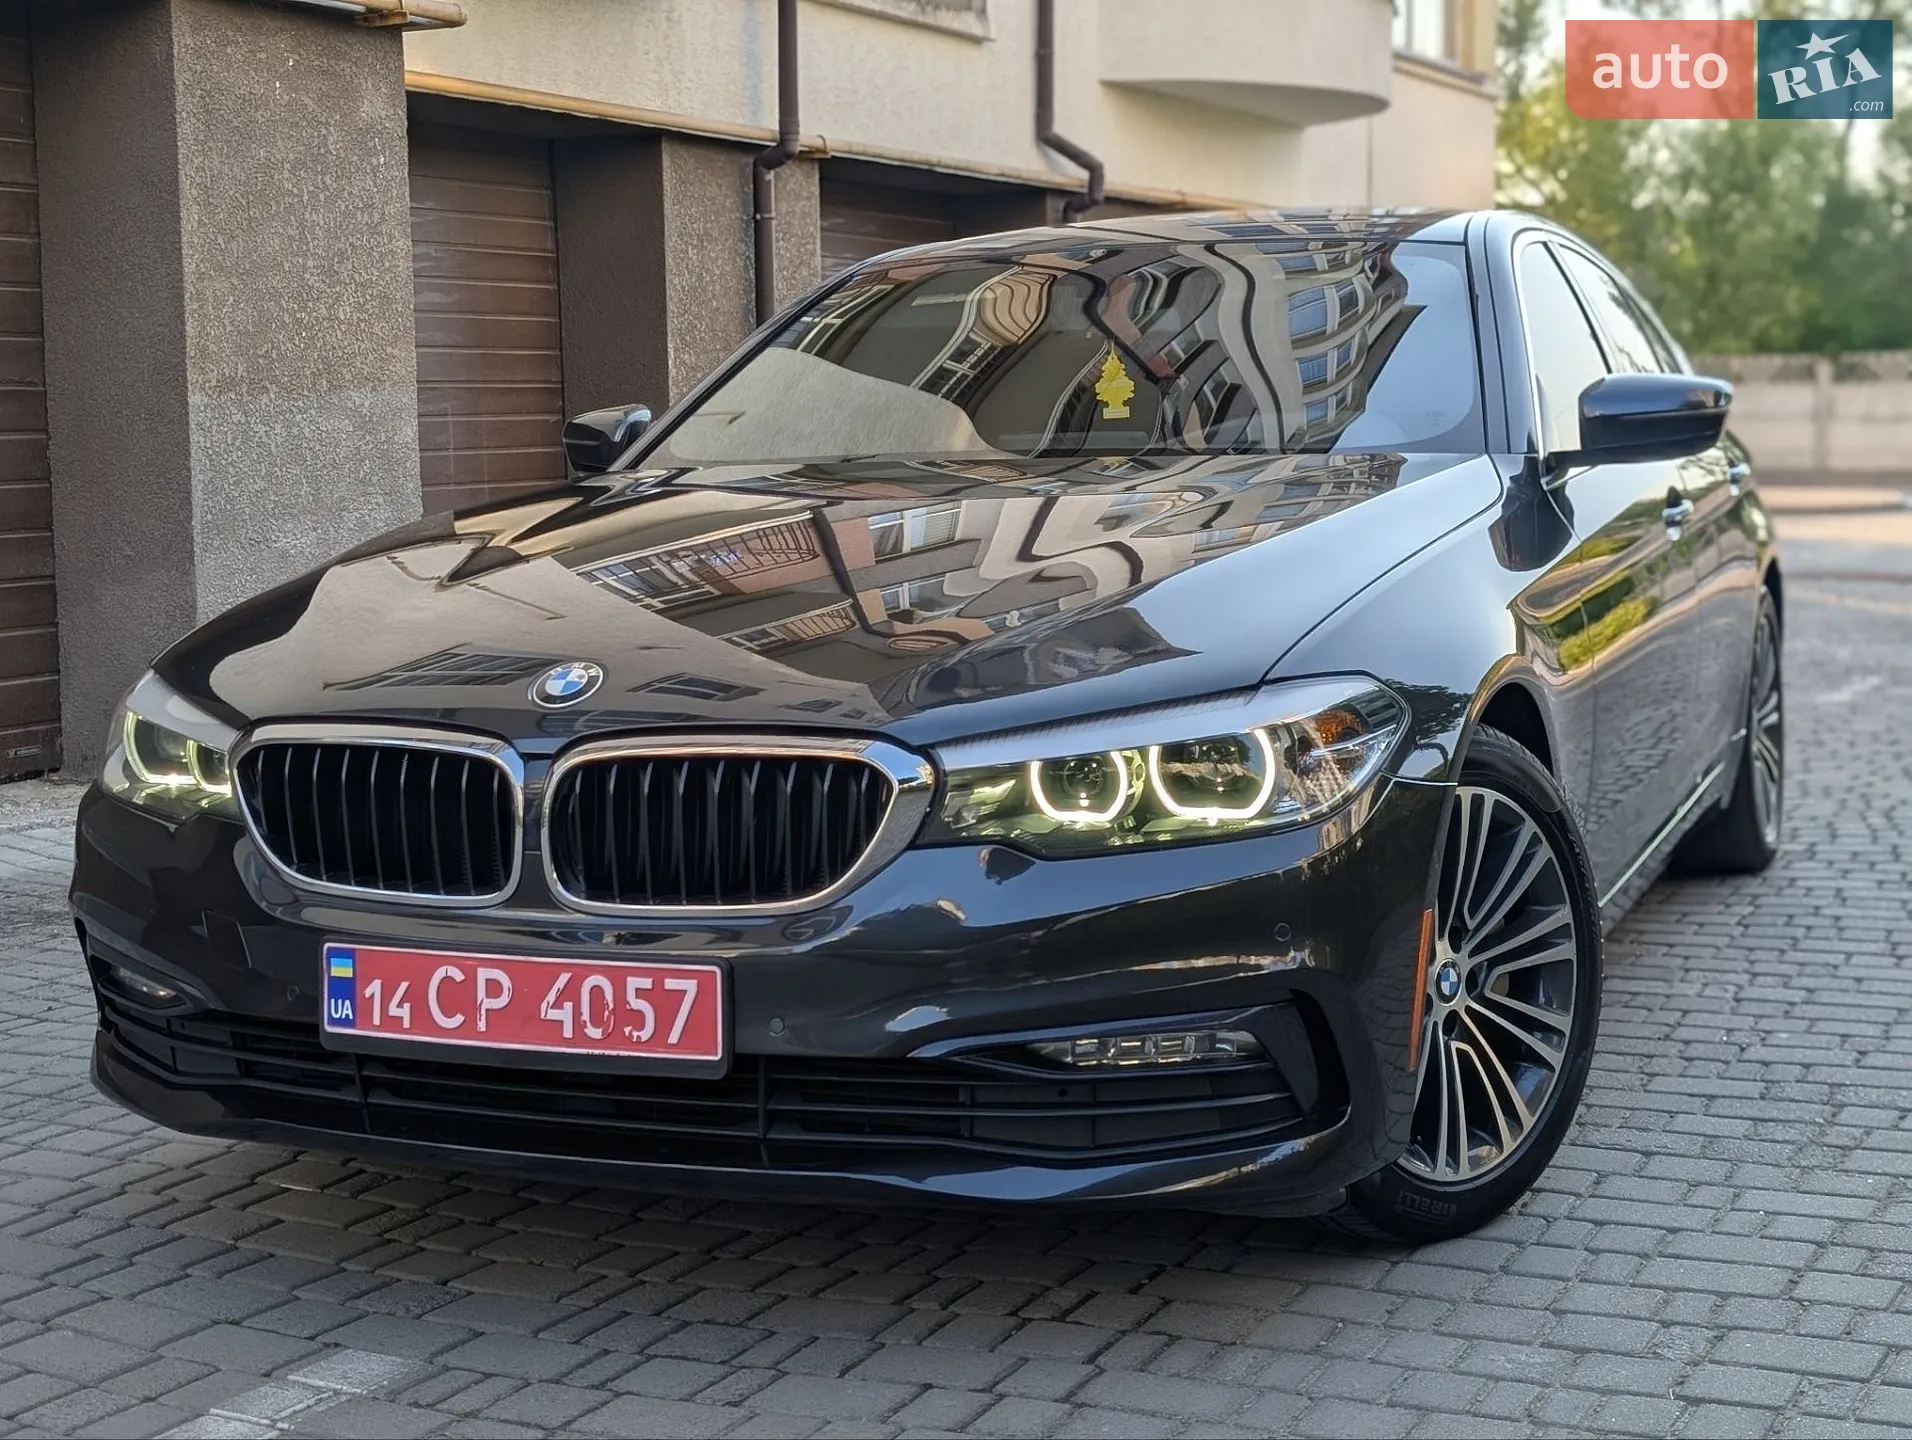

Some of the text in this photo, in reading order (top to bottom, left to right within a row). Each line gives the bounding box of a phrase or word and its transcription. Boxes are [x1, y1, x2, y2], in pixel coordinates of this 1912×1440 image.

[330, 998, 354, 1020] UA
[363, 965, 699, 1046] 14 CP 4057
